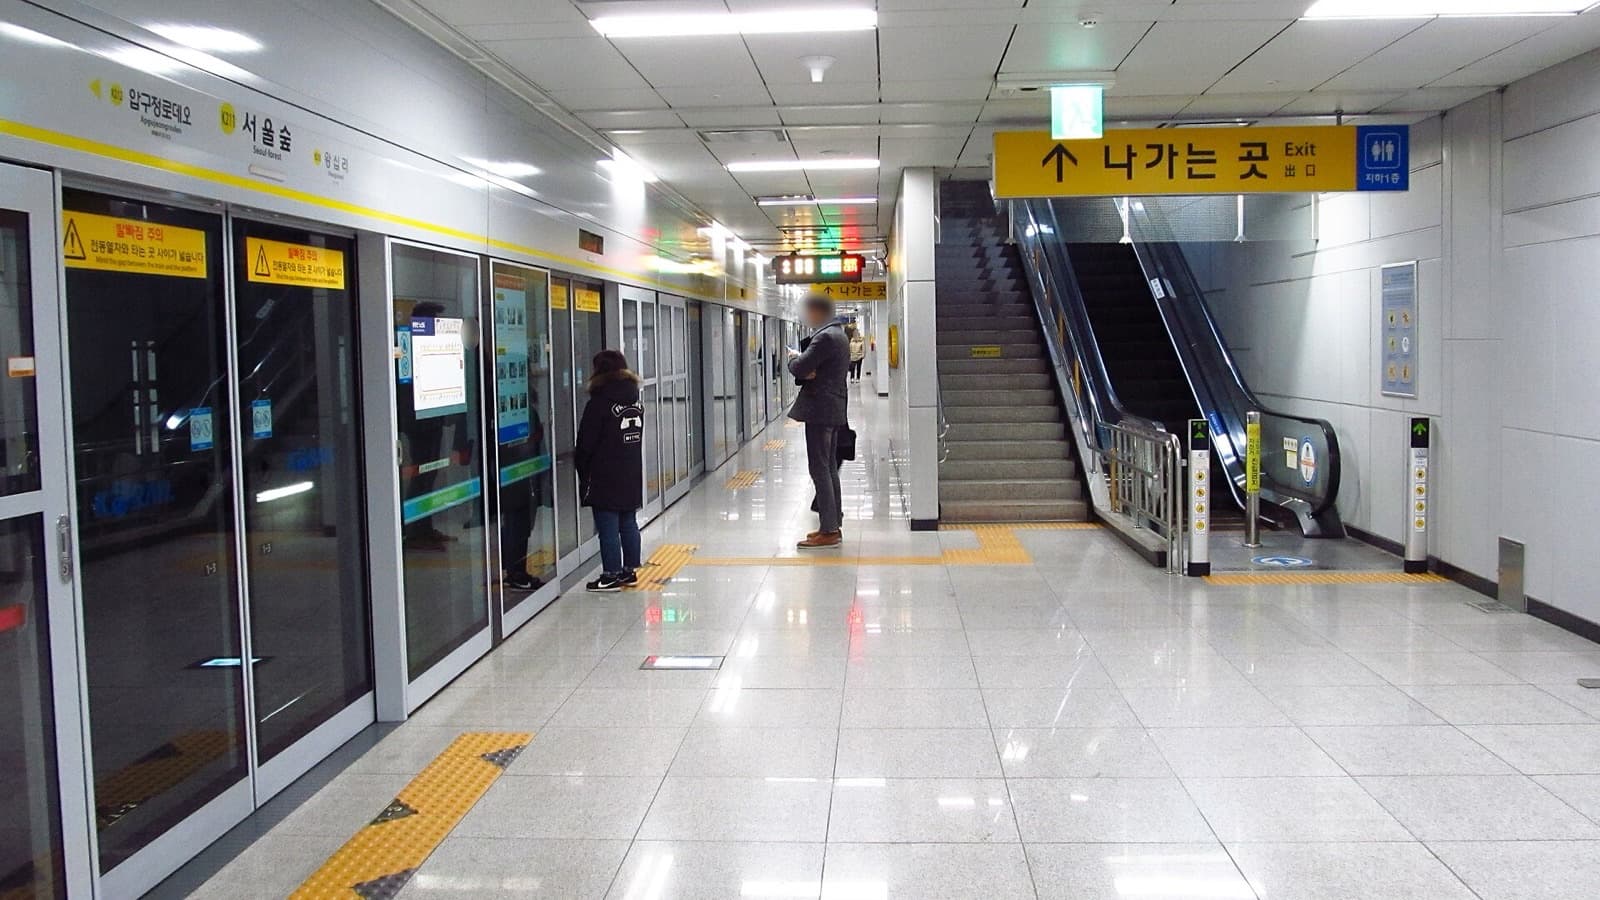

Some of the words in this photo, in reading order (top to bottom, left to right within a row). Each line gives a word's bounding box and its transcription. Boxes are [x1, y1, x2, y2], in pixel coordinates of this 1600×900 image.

[129, 88, 192, 125] 압구정로데오
[242, 111, 292, 152] 서울숲
[253, 145, 267, 156] Seoul
[1285, 142, 1316, 156] Exit
[324, 152, 349, 173] 왕십리
[1104, 142, 1217, 180] 나가는
[1238, 142, 1269, 180] 곳
[1285, 164, 1316, 177] 出口
[1366, 173, 1400, 184] 지하1층
[116, 223, 144, 240] 발빠짐
[147, 227, 164, 242] 주의
[131, 244, 145, 258] 타는
[157, 247, 177, 261] 사이가
[840, 285, 873, 297] 나가는
